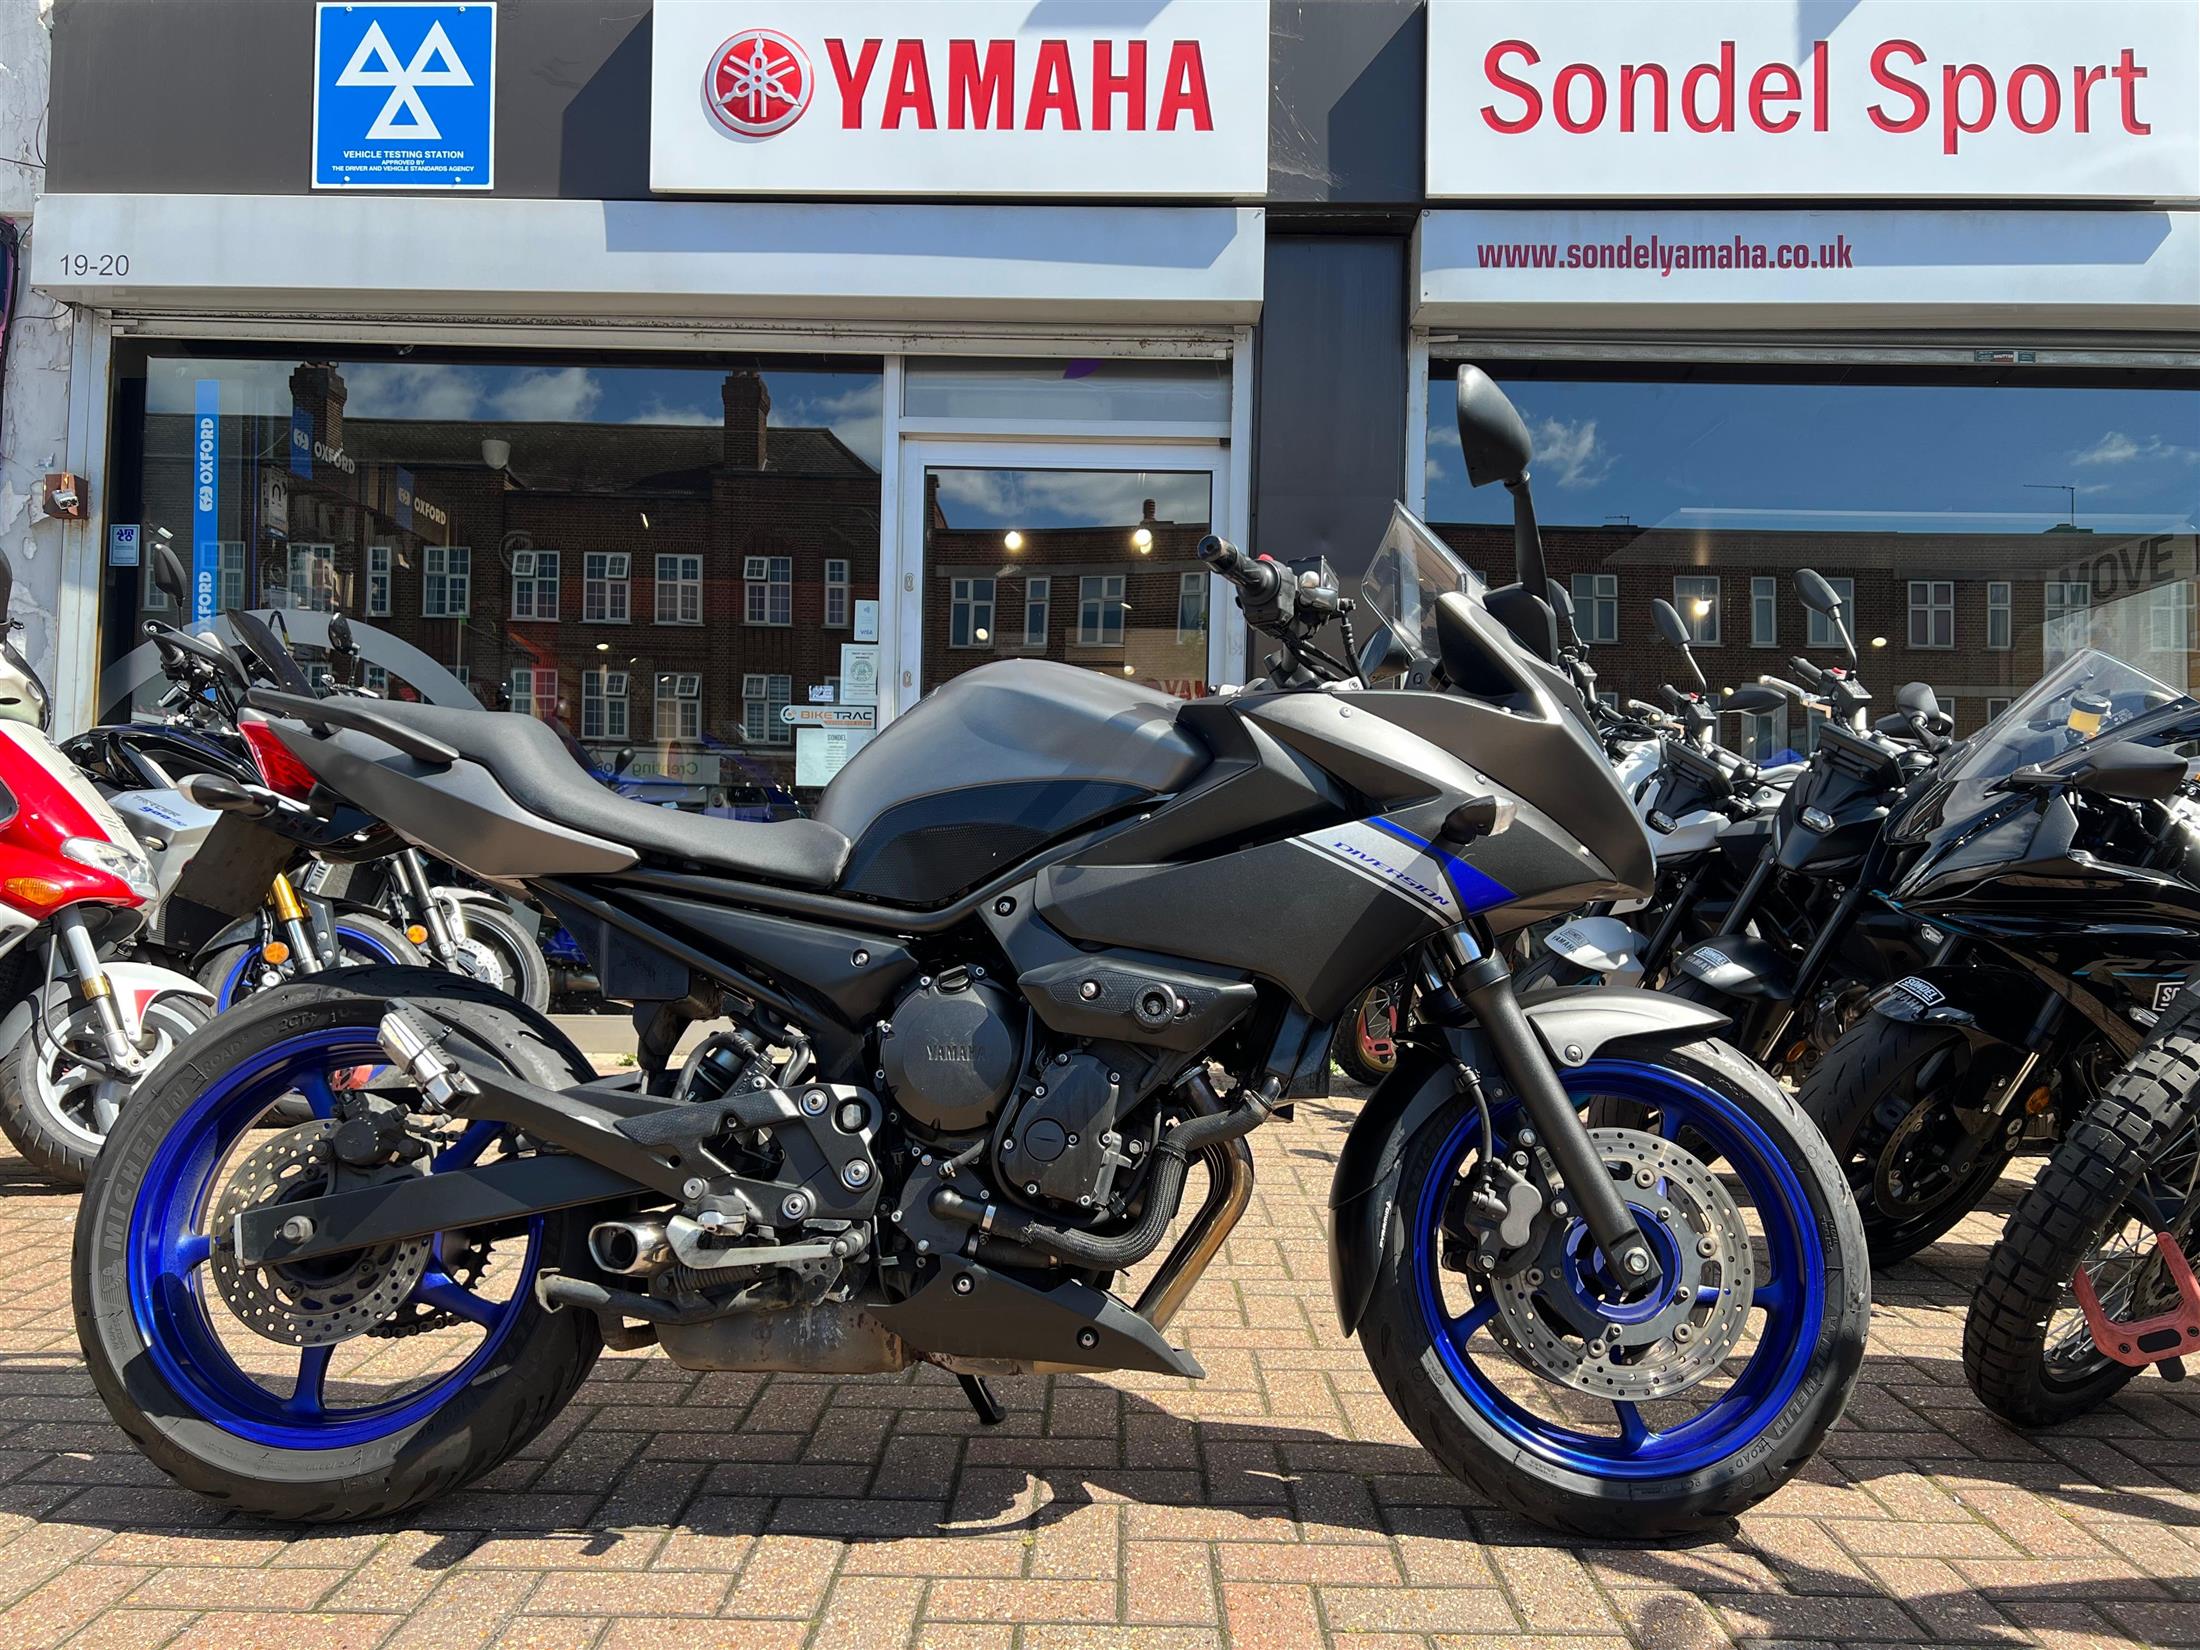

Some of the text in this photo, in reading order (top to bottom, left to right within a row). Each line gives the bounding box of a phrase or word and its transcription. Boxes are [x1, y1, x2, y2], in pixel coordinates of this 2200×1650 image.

[824, 38, 1214, 131] YAMAHA
[1480, 39, 2152, 155] Sondel Sport
[343, 150, 464, 159] VEHICLE TESTING STATION
[60, 254, 130, 276] 19-20
[1477, 234, 1853, 276] www.sondelyamaha.co.uk
[199, 418, 214, 483] OXFORD
[314, 441, 356, 475] OXFORD
[414, 497, 447, 526] OXFORD
[800, 710, 872, 720] BIKETRAC
[1333, 841, 1450, 906] DIVERSION
[1904, 978, 1938, 1001] SONDEL
[926, 1045, 985, 1061] YAMAHA
[103, 1083, 190, 1253] MICHELIN
[1775, 1314, 1840, 1438] MICHELIN
